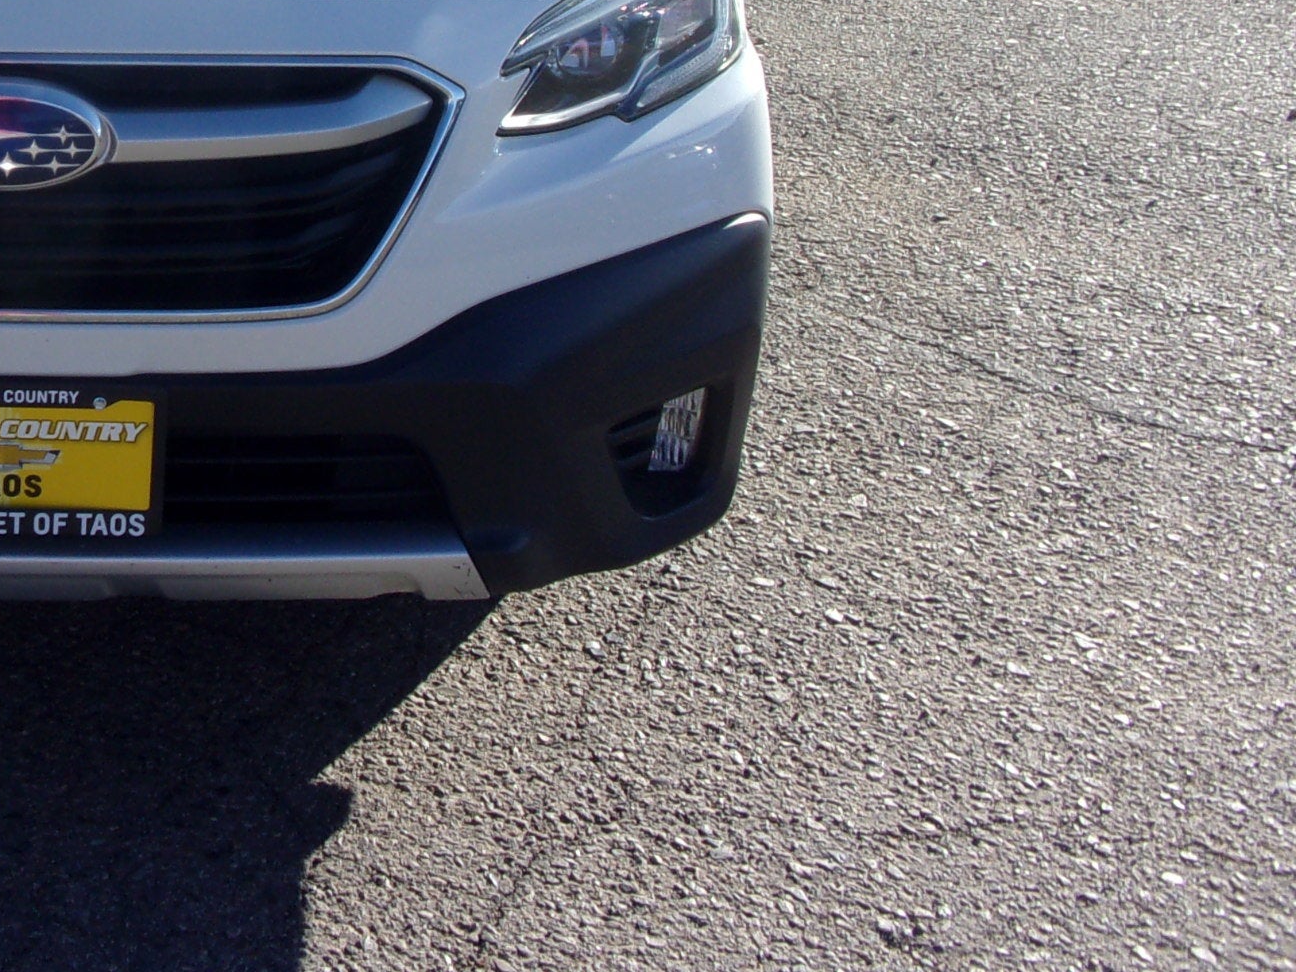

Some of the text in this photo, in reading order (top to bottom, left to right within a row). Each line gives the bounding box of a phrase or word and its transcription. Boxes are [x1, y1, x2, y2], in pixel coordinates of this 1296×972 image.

[3, 389, 79, 405] COUNTRY
[33, 512, 69, 536] OF
[76, 512, 146, 537] TAOS
